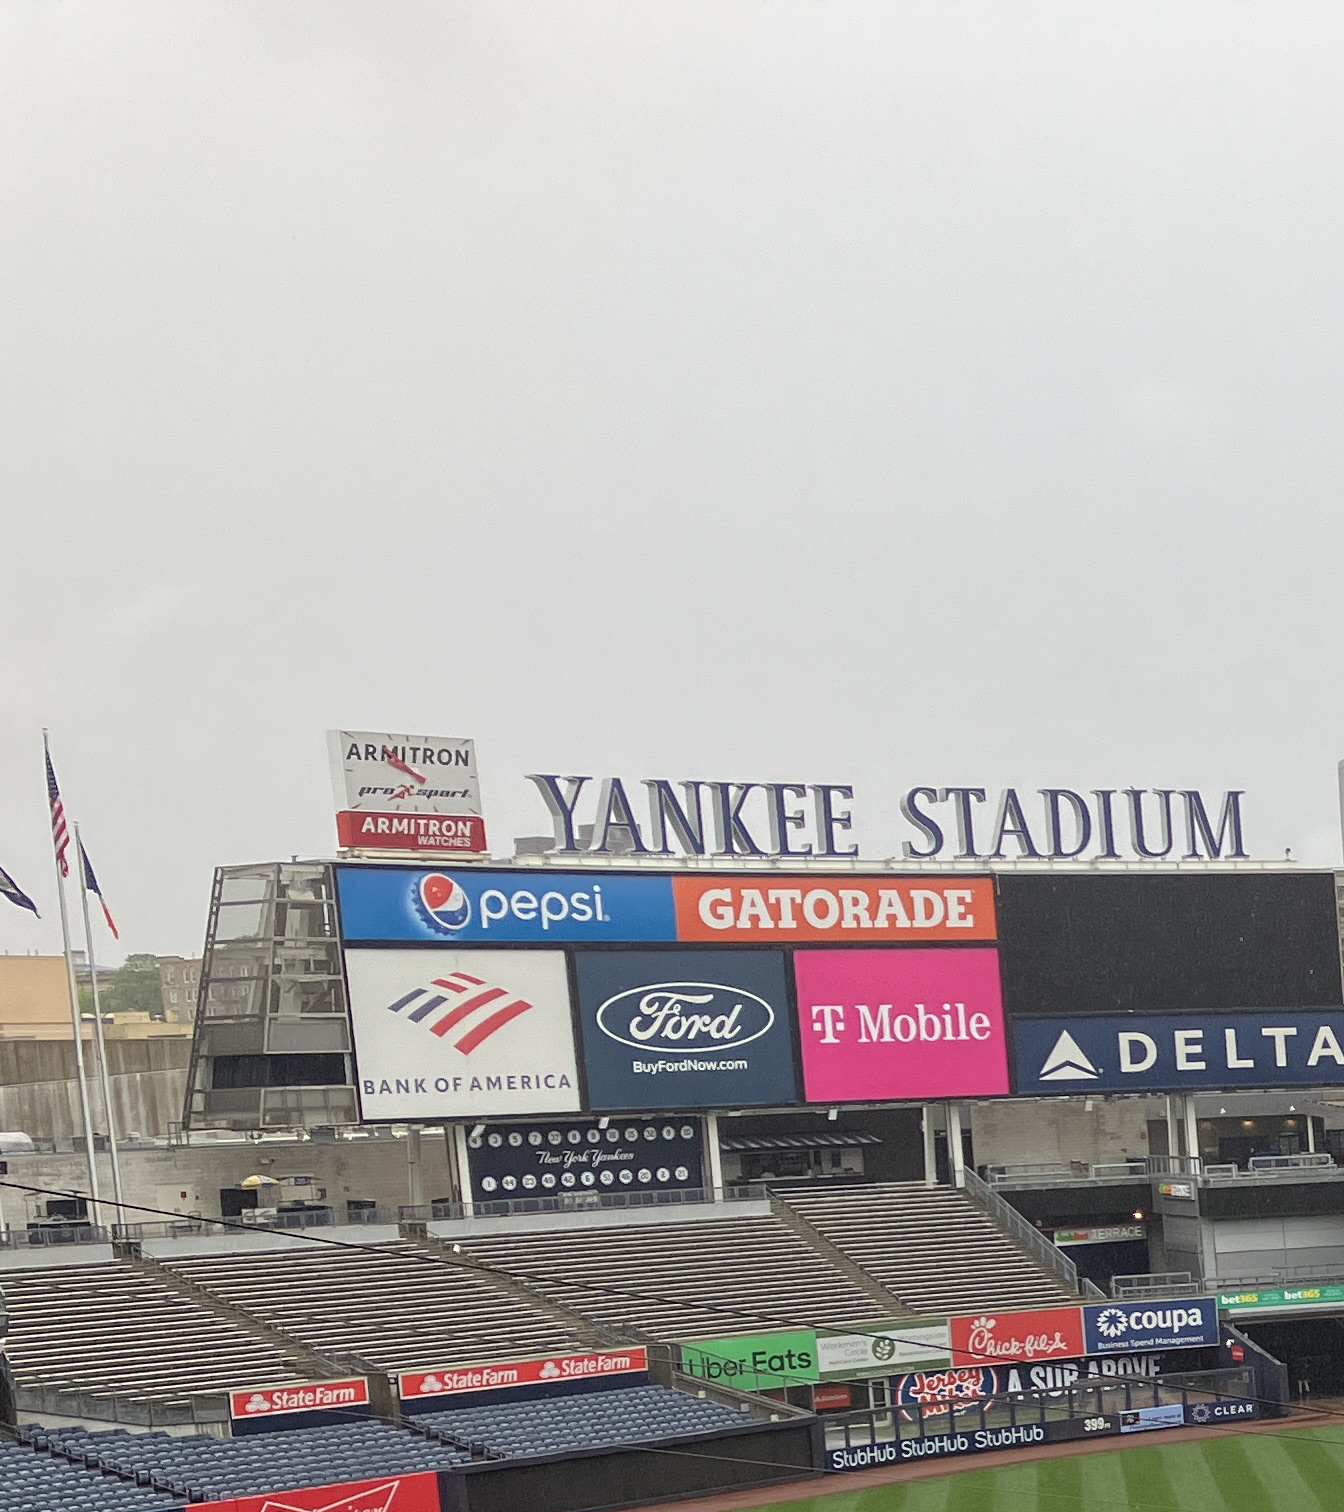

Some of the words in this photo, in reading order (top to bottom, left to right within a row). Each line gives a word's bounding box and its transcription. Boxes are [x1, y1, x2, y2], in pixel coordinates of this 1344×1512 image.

[346, 743, 469, 767] ARMITRON
[361, 816, 471, 837] ARMITRON
[525, 773, 859, 857] YANKEE
[900, 786, 1249, 860] STADIUM
[417, 835, 471, 847] WATCHES
[480, 885, 603, 931] pepsi
[698, 888, 974, 930] GATORADE
[629, 991, 742, 1041] Ford
[857, 1002, 991, 1043] Mobile
[632, 1058, 748, 1074] BuyFordNow.com
[364, 1077, 428, 1096] BANK
[436, 1076, 463, 1093] OF
[469, 1073, 572, 1092] AMERICA
[536, 1151, 562, 1164] New
[562, 1151, 588, 1168] York
[590, 1149, 634, 1167] Yankees
[1092, 1226, 1142, 1239] TERRACE
[1221, 1293, 1257, 1304] bet365
[1284, 1289, 1320, 1300] bet365
[1130, 1307, 1203, 1333] coupa
[969, 1325, 1068, 1358] Chick-fil-A
[1098, 1340, 1130, 1350] Business
[1131, 1338, 1154, 1349] Spend
[1156, 1335, 1204, 1346] Management
[561, 1354, 630, 1376] StateFarm
[752, 1350, 812, 1373] Eats
[443, 1367, 517, 1391] StateFarm
[910, 1366, 984, 1394] Jersey
[272, 1386, 354, 1409] StateFarm
[1214, 1404, 1253, 1416] CLEAR
[1084, 1417, 1105, 1431] 399
[832, 1448, 896, 1469] StubHub
[901, 1433, 968, 1459] StubHub
[975, 1425, 1044, 1449] StubHub
